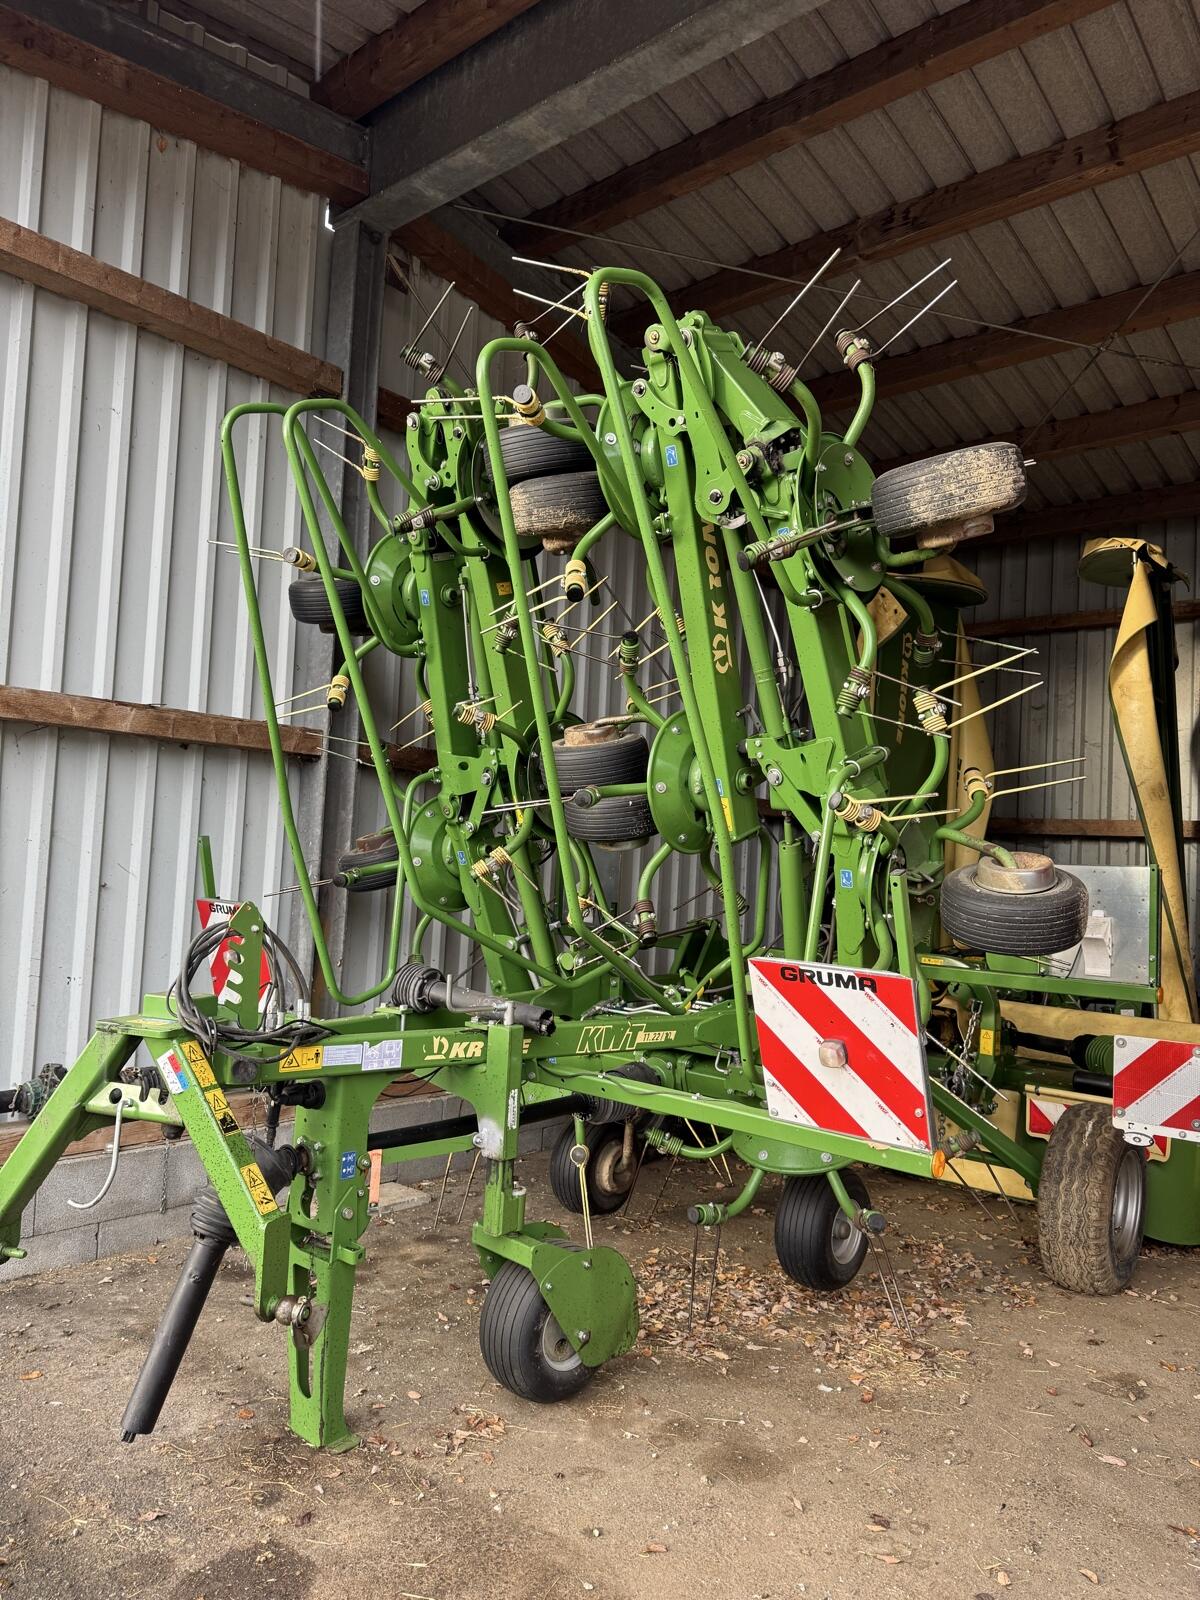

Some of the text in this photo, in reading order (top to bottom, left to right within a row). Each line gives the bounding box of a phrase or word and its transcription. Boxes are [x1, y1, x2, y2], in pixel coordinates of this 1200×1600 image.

[208, 902, 240, 917] GRUM
[780, 966, 878, 994] GRUMA
[449, 1038, 532, 1059] KRE
[575, 1024, 647, 1054] KWT
